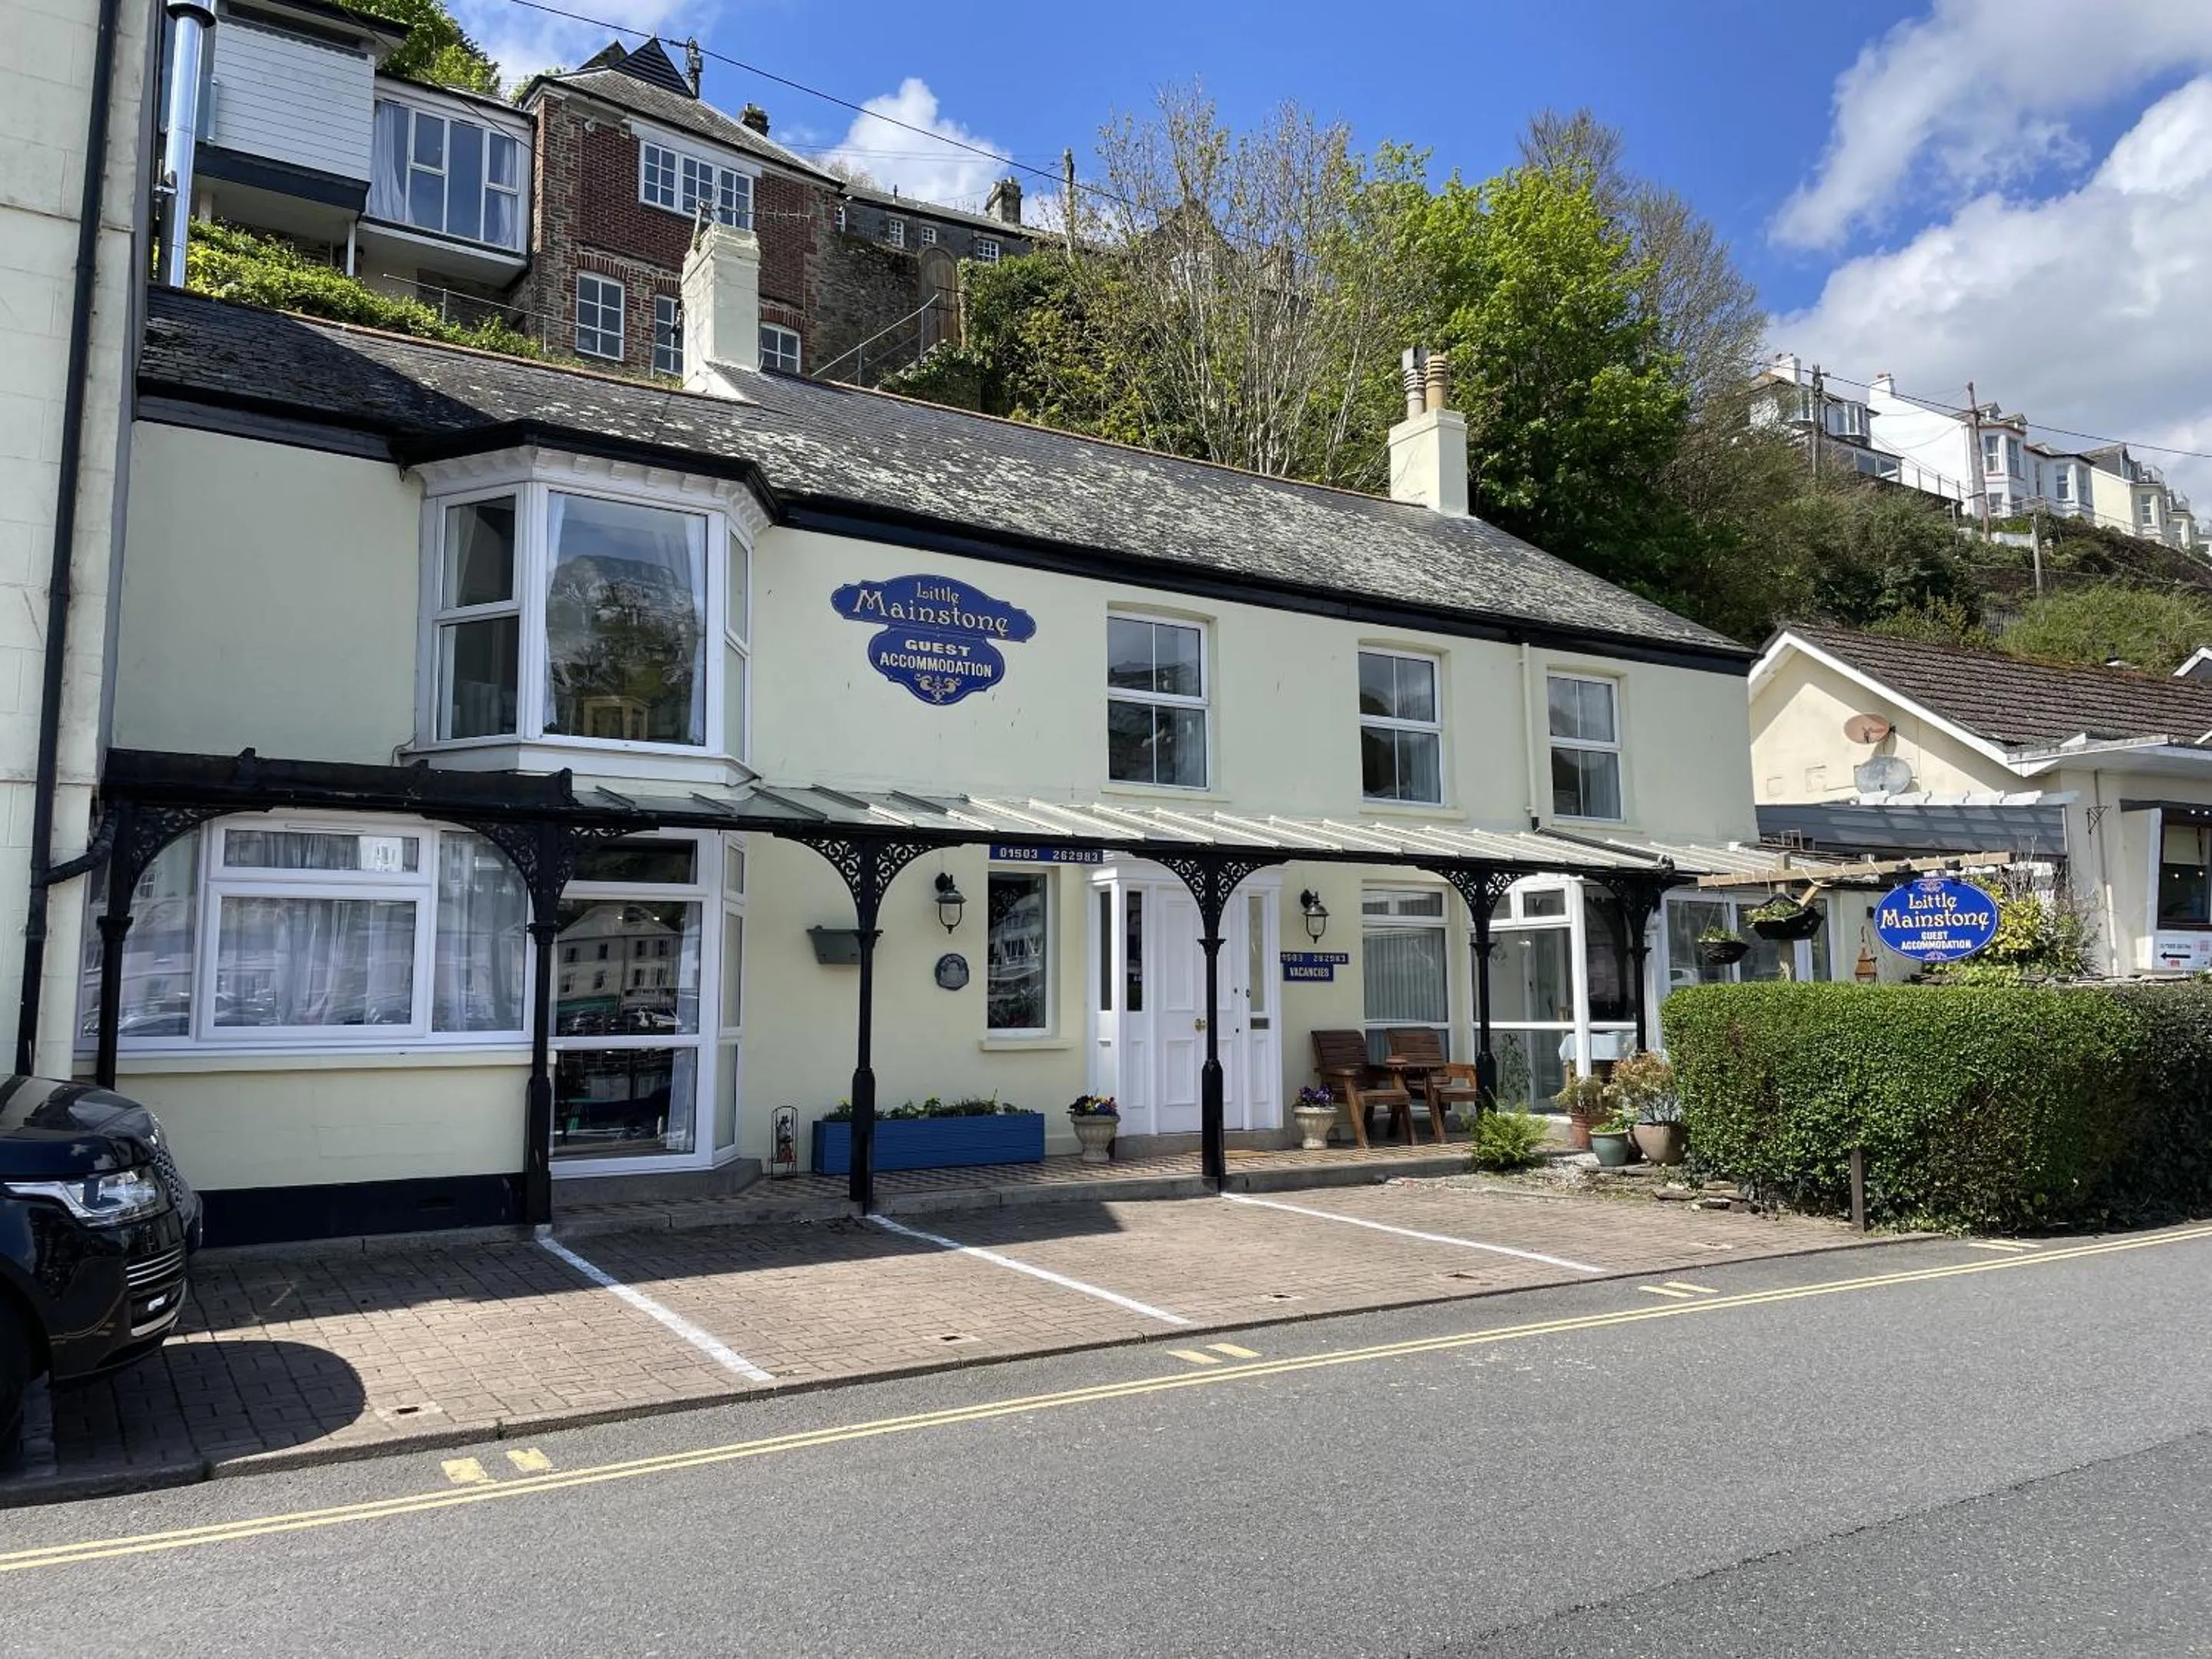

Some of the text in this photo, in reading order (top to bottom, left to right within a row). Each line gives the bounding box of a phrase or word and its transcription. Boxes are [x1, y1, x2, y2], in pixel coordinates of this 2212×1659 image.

[916, 581, 961, 607] Little
[852, 589, 1010, 636] Mainstone
[904, 639, 971, 657] GUEST
[879, 651, 993, 678] ACCOMMODATION
[1000, 847, 1038, 859] 01503
[1908, 891, 1958, 911] Little
[1880, 908, 1990, 931] Mainstone
[1900, 939, 1972, 950] ACCOMMODATION
[1920, 930, 1949, 940] GUEST
[1289, 967, 1330, 977] VACANCIES
